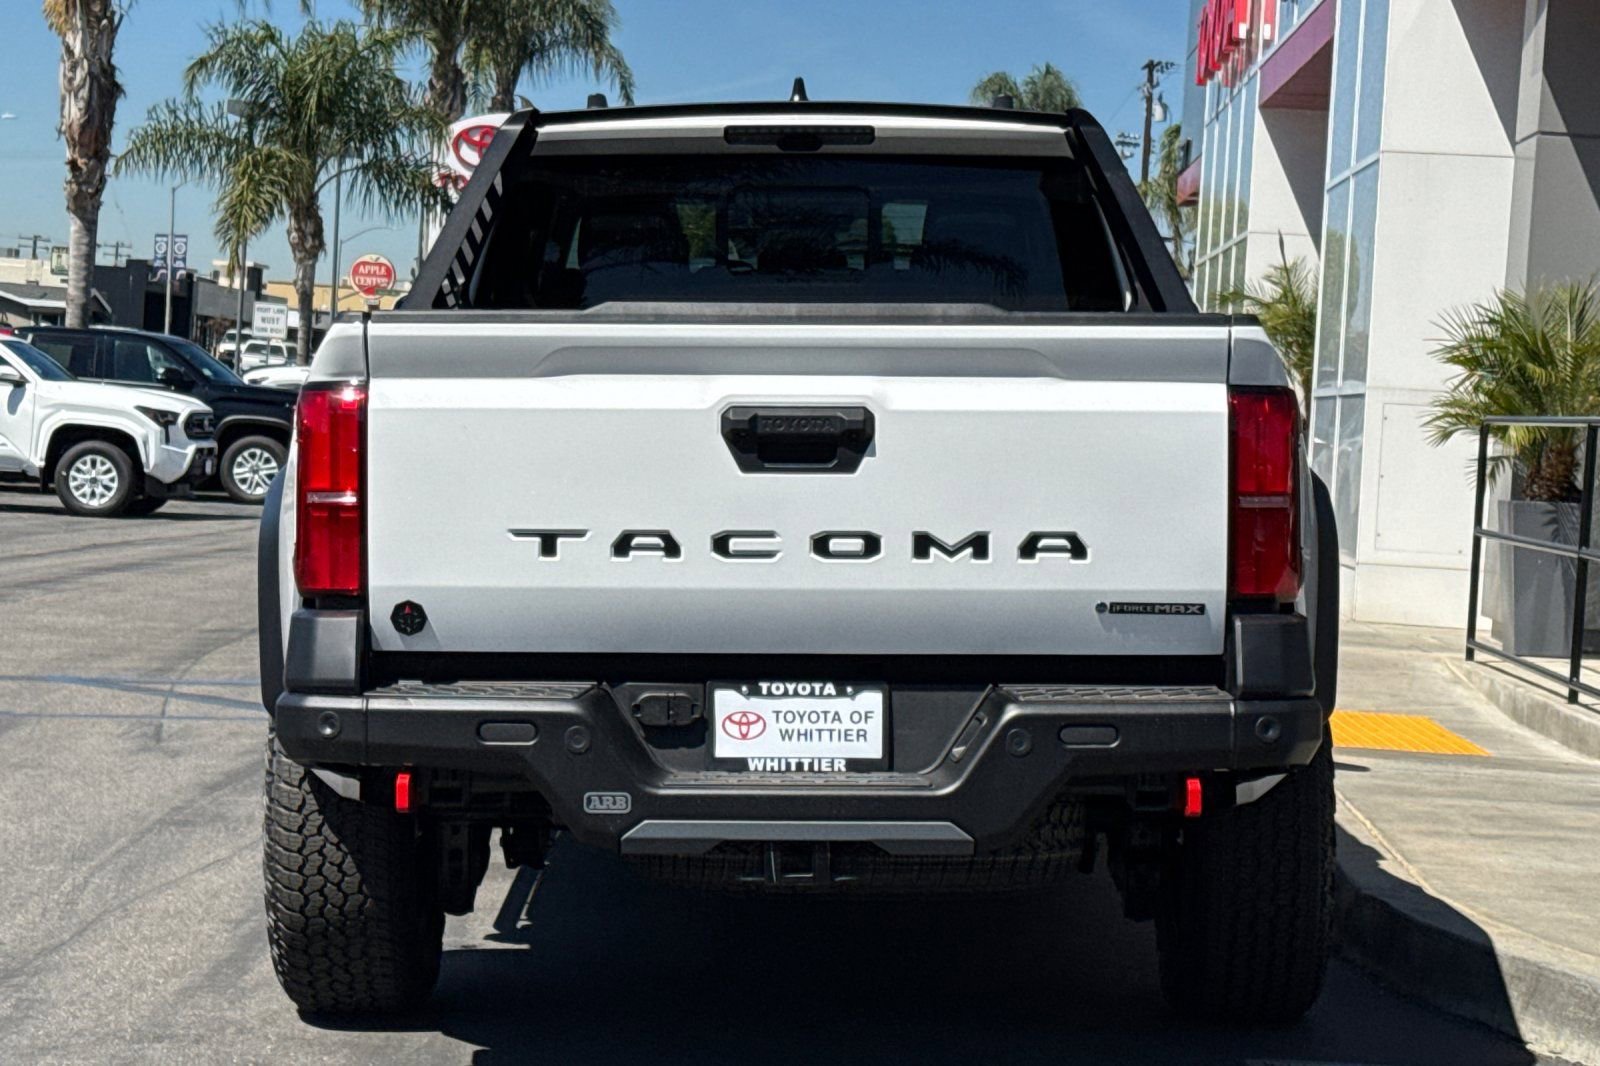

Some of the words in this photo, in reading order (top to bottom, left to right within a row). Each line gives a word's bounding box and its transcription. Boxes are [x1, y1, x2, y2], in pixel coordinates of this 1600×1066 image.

[358, 264, 387, 276] APPLE
[261, 316, 280, 325] MUST
[762, 418, 835, 431] TOYOTA
[507, 528, 1091, 563] TACOMA
[758, 682, 837, 696] TOYOTA
[772, 710, 843, 724] TOYOTA
[849, 710, 875, 724] OF
[779, 728, 868, 742] WHITTIER
[747, 758, 847, 772] WHITTIER
[589, 796, 626, 810] ARB
